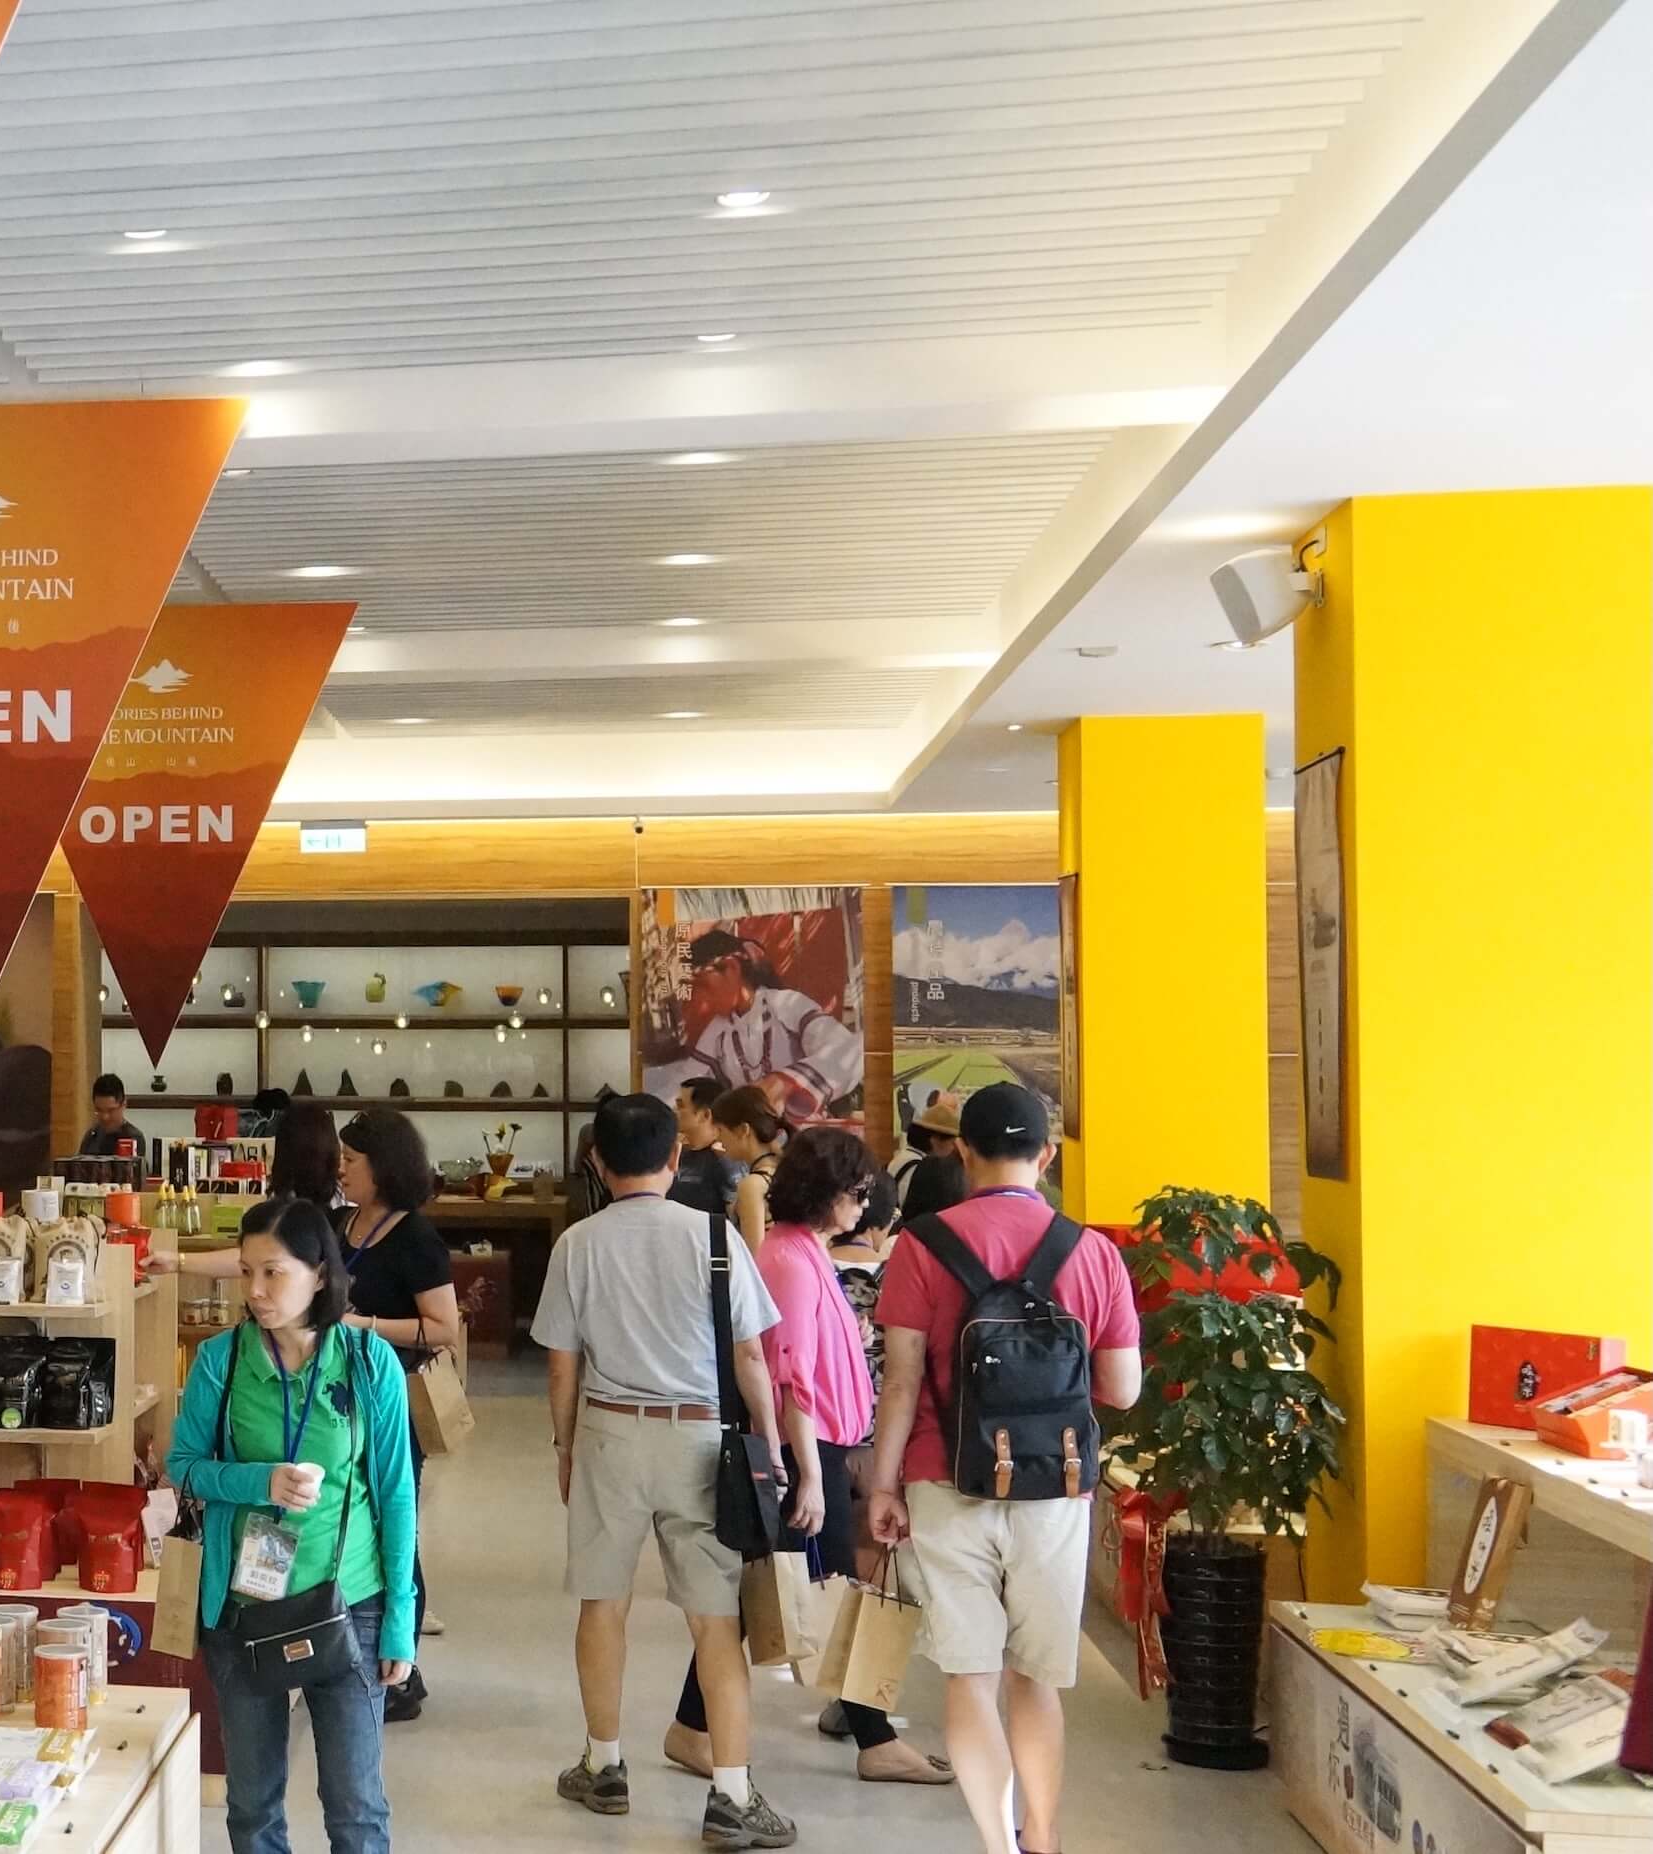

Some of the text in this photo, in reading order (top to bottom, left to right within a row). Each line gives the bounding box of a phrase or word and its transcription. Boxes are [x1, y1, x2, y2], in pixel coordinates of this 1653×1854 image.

[113, 706, 224, 720] ORIES BEHIND
[124, 727, 235, 744] MOUNTAIN
[79, 804, 234, 843] OPEN
